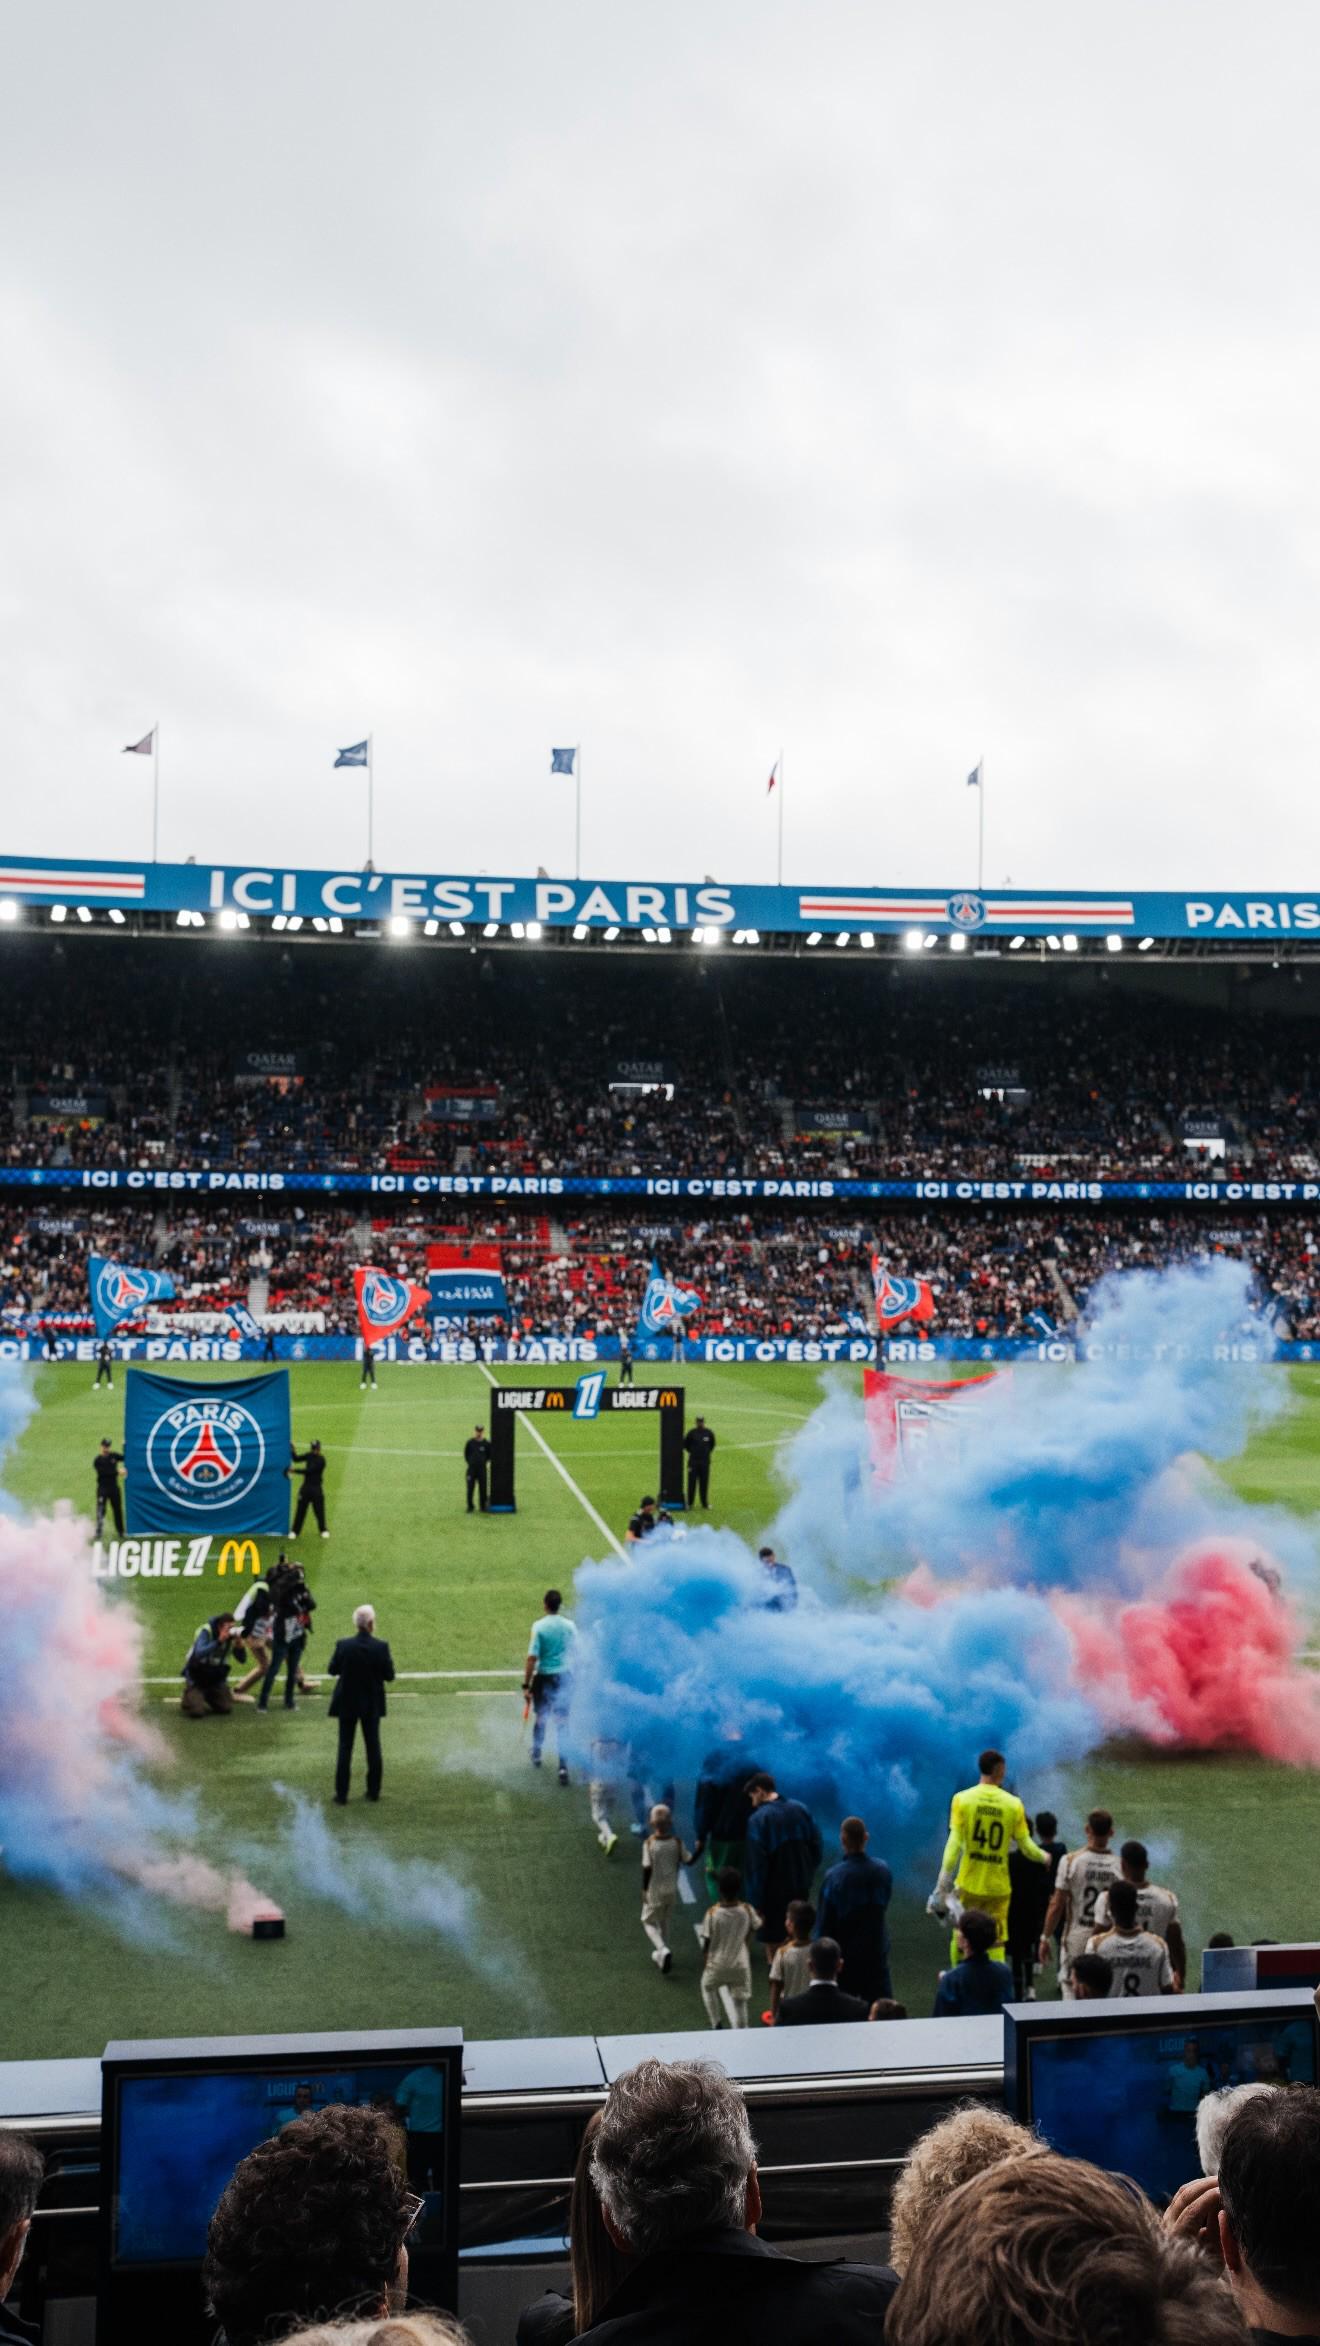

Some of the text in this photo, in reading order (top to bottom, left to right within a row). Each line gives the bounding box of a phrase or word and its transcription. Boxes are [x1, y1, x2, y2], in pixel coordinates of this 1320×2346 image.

[209, 870, 736, 925] ICI C'EST PARIS
[1185, 901, 1320, 930] PARIS
[82, 1170, 285, 1190] ICI C'EST PARIS
[370, 1175, 564, 1194] ICI C'EST PARIS
[647, 1179, 835, 1197] ICI C'EST PARIS
[916, 1182, 1103, 1199] ICI C'EST PARIS
[1185, 1183, 1320, 1200] ICI C'EST P
[42, 1341, 137, 1361] C'ET
[146, 1341, 242, 1361] PARIS
[705, 1341, 745, 1361] ICI
[755, 1341, 844, 1361] C'EST
[167, 1403, 246, 1431] PARIS
[972, 1818, 1004, 1850] 40
[1124, 1973, 1141, 1997] 8
